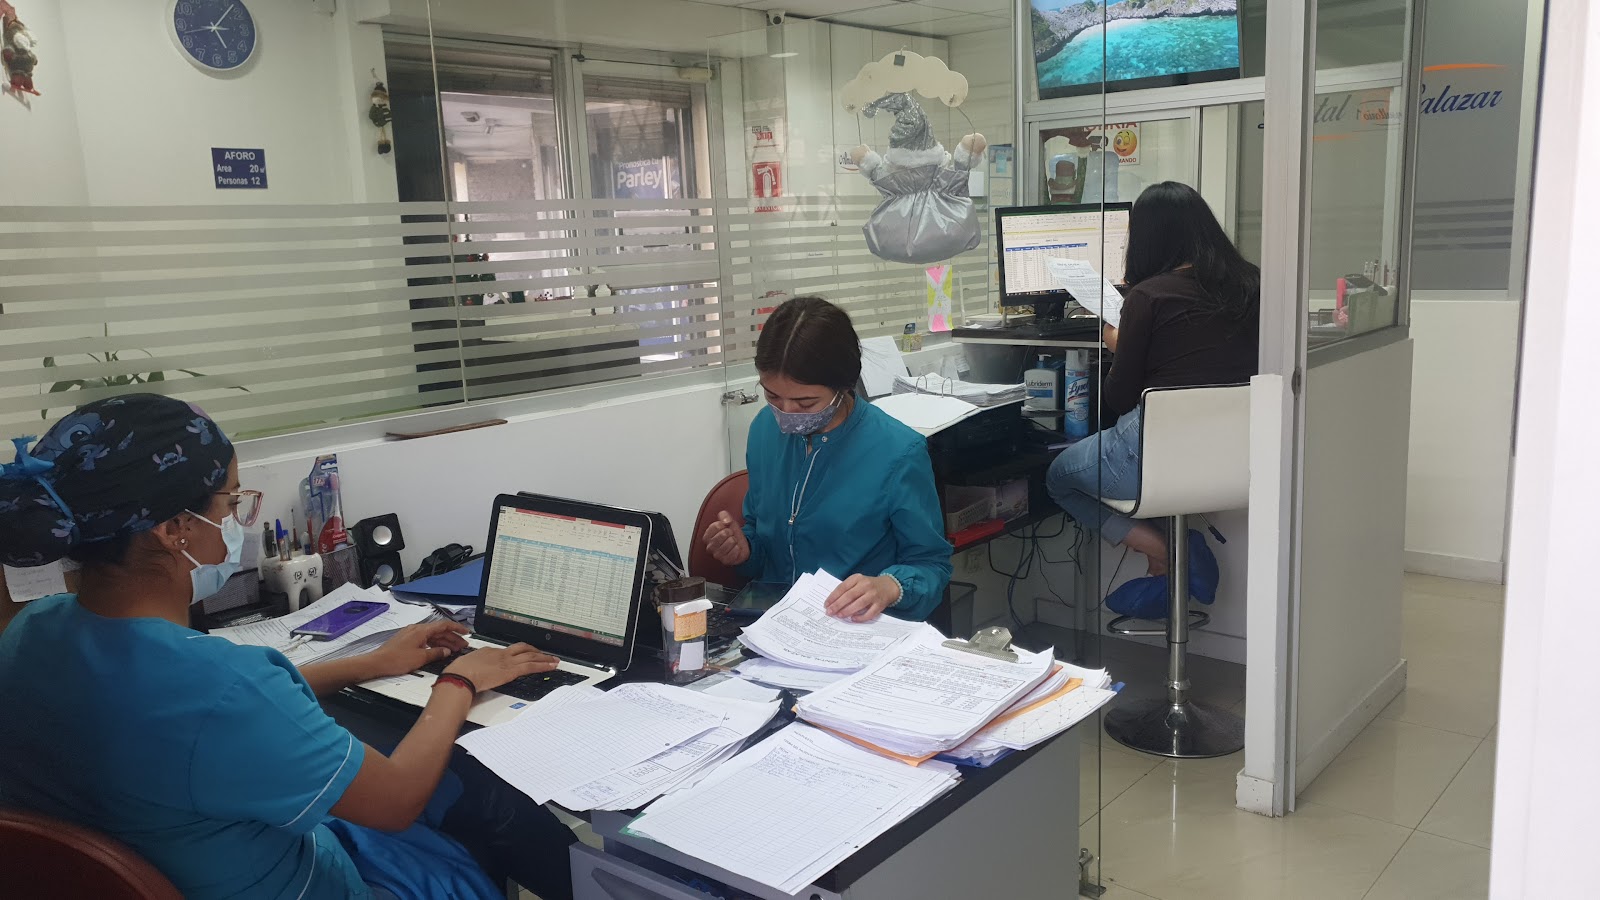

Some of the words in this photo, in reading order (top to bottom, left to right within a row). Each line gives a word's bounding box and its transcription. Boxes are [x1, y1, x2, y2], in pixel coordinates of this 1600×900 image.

[224, 151, 256, 161] AFORO
[216, 163, 233, 173] Area
[249, 164, 259, 173] 20
[217, 176, 249, 185] Personas
[250, 176, 261, 185] 12
[617, 166, 663, 189] Parley
[1025, 379, 1053, 387] Lubriderm
